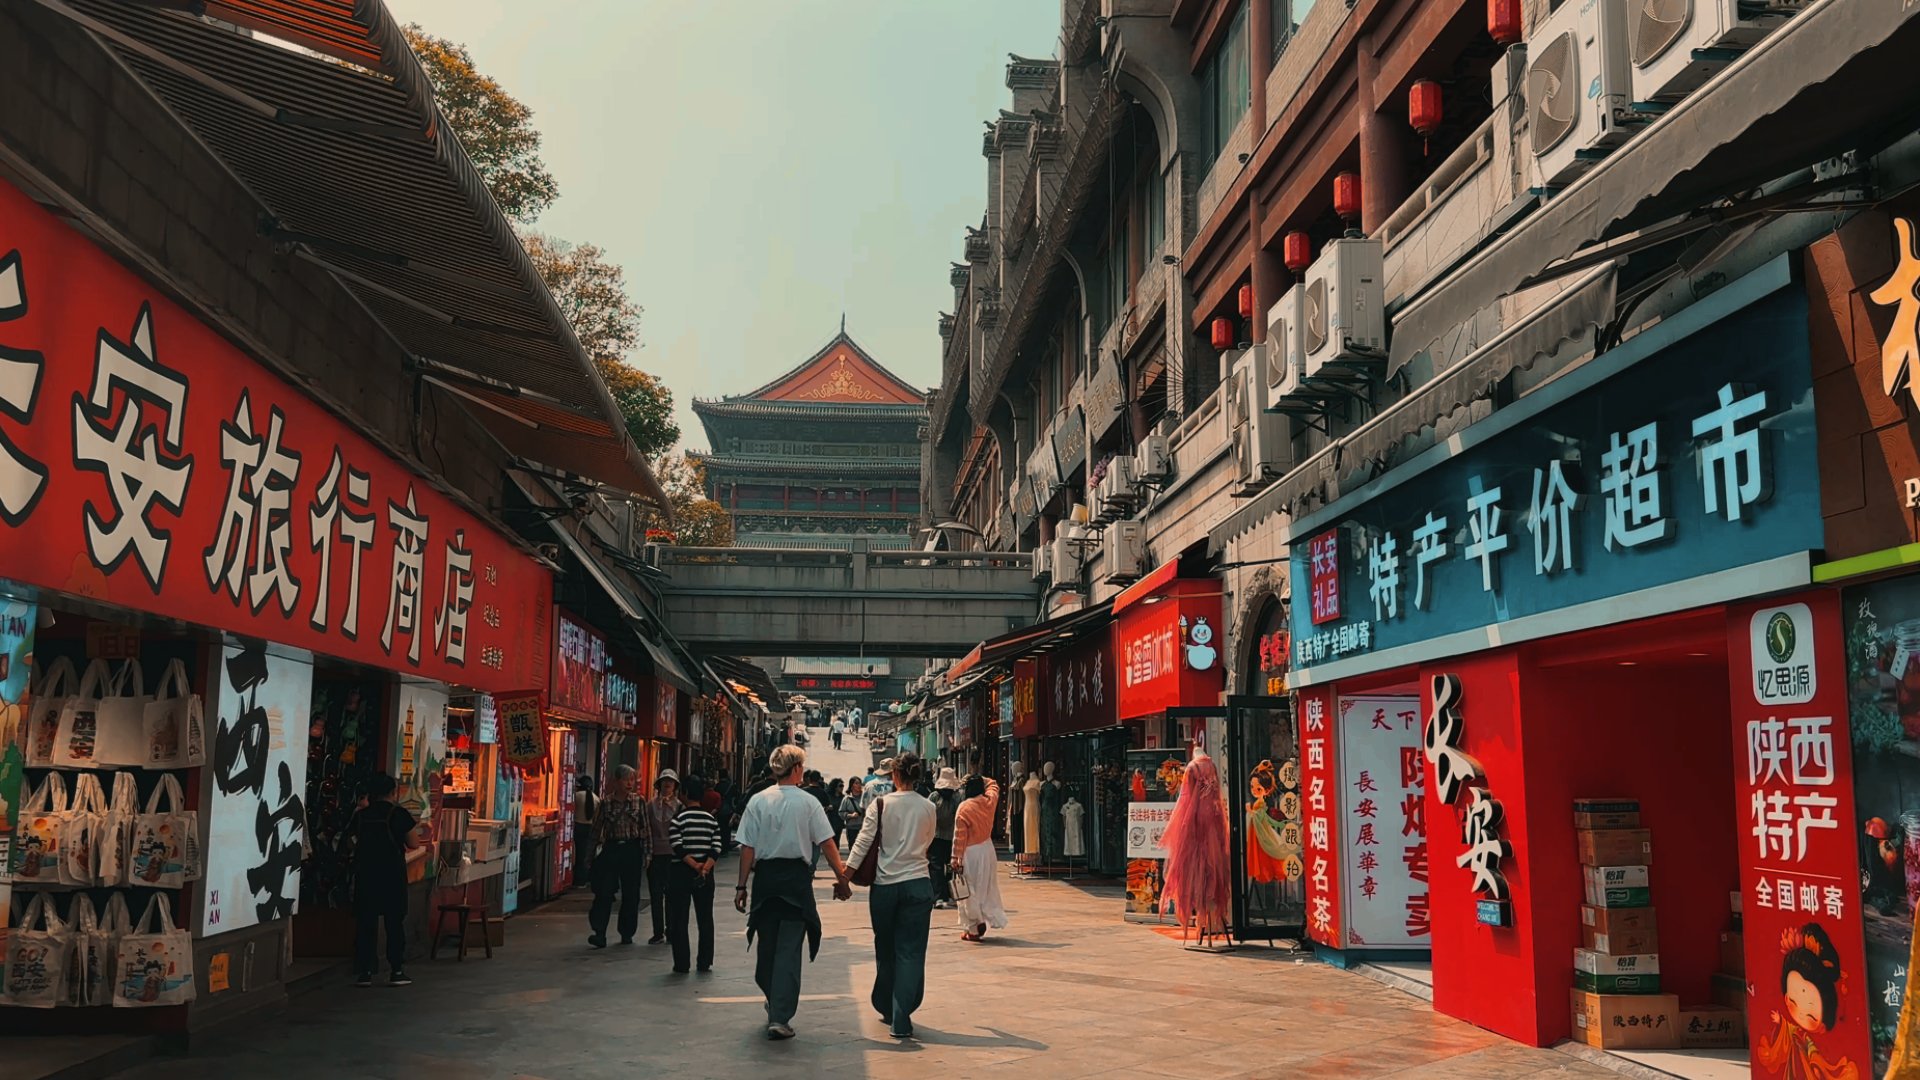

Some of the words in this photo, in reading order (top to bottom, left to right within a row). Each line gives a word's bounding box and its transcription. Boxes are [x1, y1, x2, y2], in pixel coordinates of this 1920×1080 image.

[1368, 383, 1768, 622] 特产平价超市
[1312, 535, 1336, 578] 长安
[1313, 578, 1338, 620] 礼品
[0, 614, 26, 638] I'AN
[1296, 620, 1370, 664] 陕西特产全国邮寄
[1858, 597, 1878, 660] 玫瑰酒
[1133, 624, 1174, 685] 蜜雪冰城
[1758, 665, 1811, 699] 忆思源
[510, 713, 537, 756] 甑糕
[1371, 708, 1416, 730] 天下
[1747, 716, 1834, 786] 陕西
[214, 633, 304, 920] 西安
[1424, 672, 1503, 899] 长安
[1283, 767, 1300, 877] 摄影跟拍
[1306, 698, 1332, 932] 陕西名烟名茶
[1353, 770, 1379, 901] 長安展華章
[1751, 789, 1838, 863] 特产
[208, 909, 221, 926] AN
[209, 890, 220, 905] XI
[1755, 876, 1844, 920] 全国邮寄
[1613, 1015, 1668, 1028] 陕西特产
